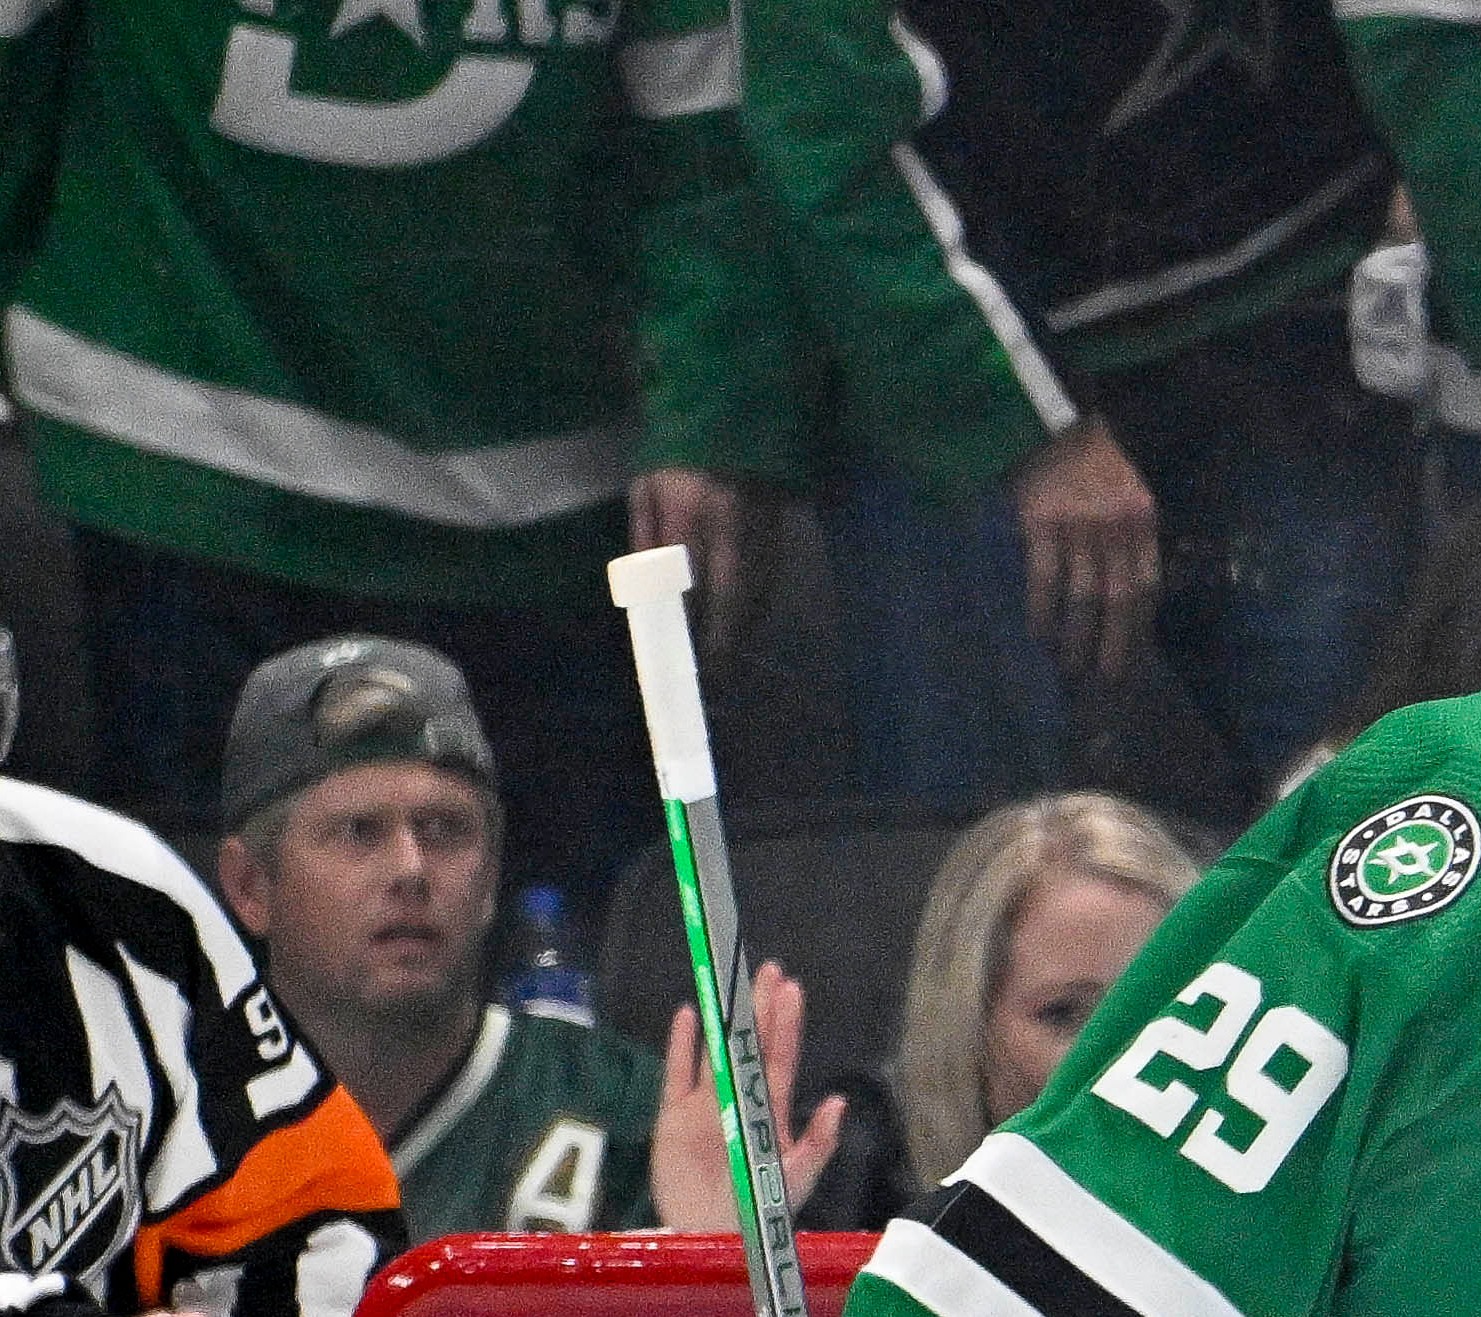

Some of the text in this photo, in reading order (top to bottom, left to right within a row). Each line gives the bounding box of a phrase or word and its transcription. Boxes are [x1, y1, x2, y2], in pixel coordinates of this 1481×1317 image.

[1339, 803, 1471, 917] DALLAS STARS
[1092, 962, 1352, 1194] 29
[25, 1129, 119, 1268] NHL
